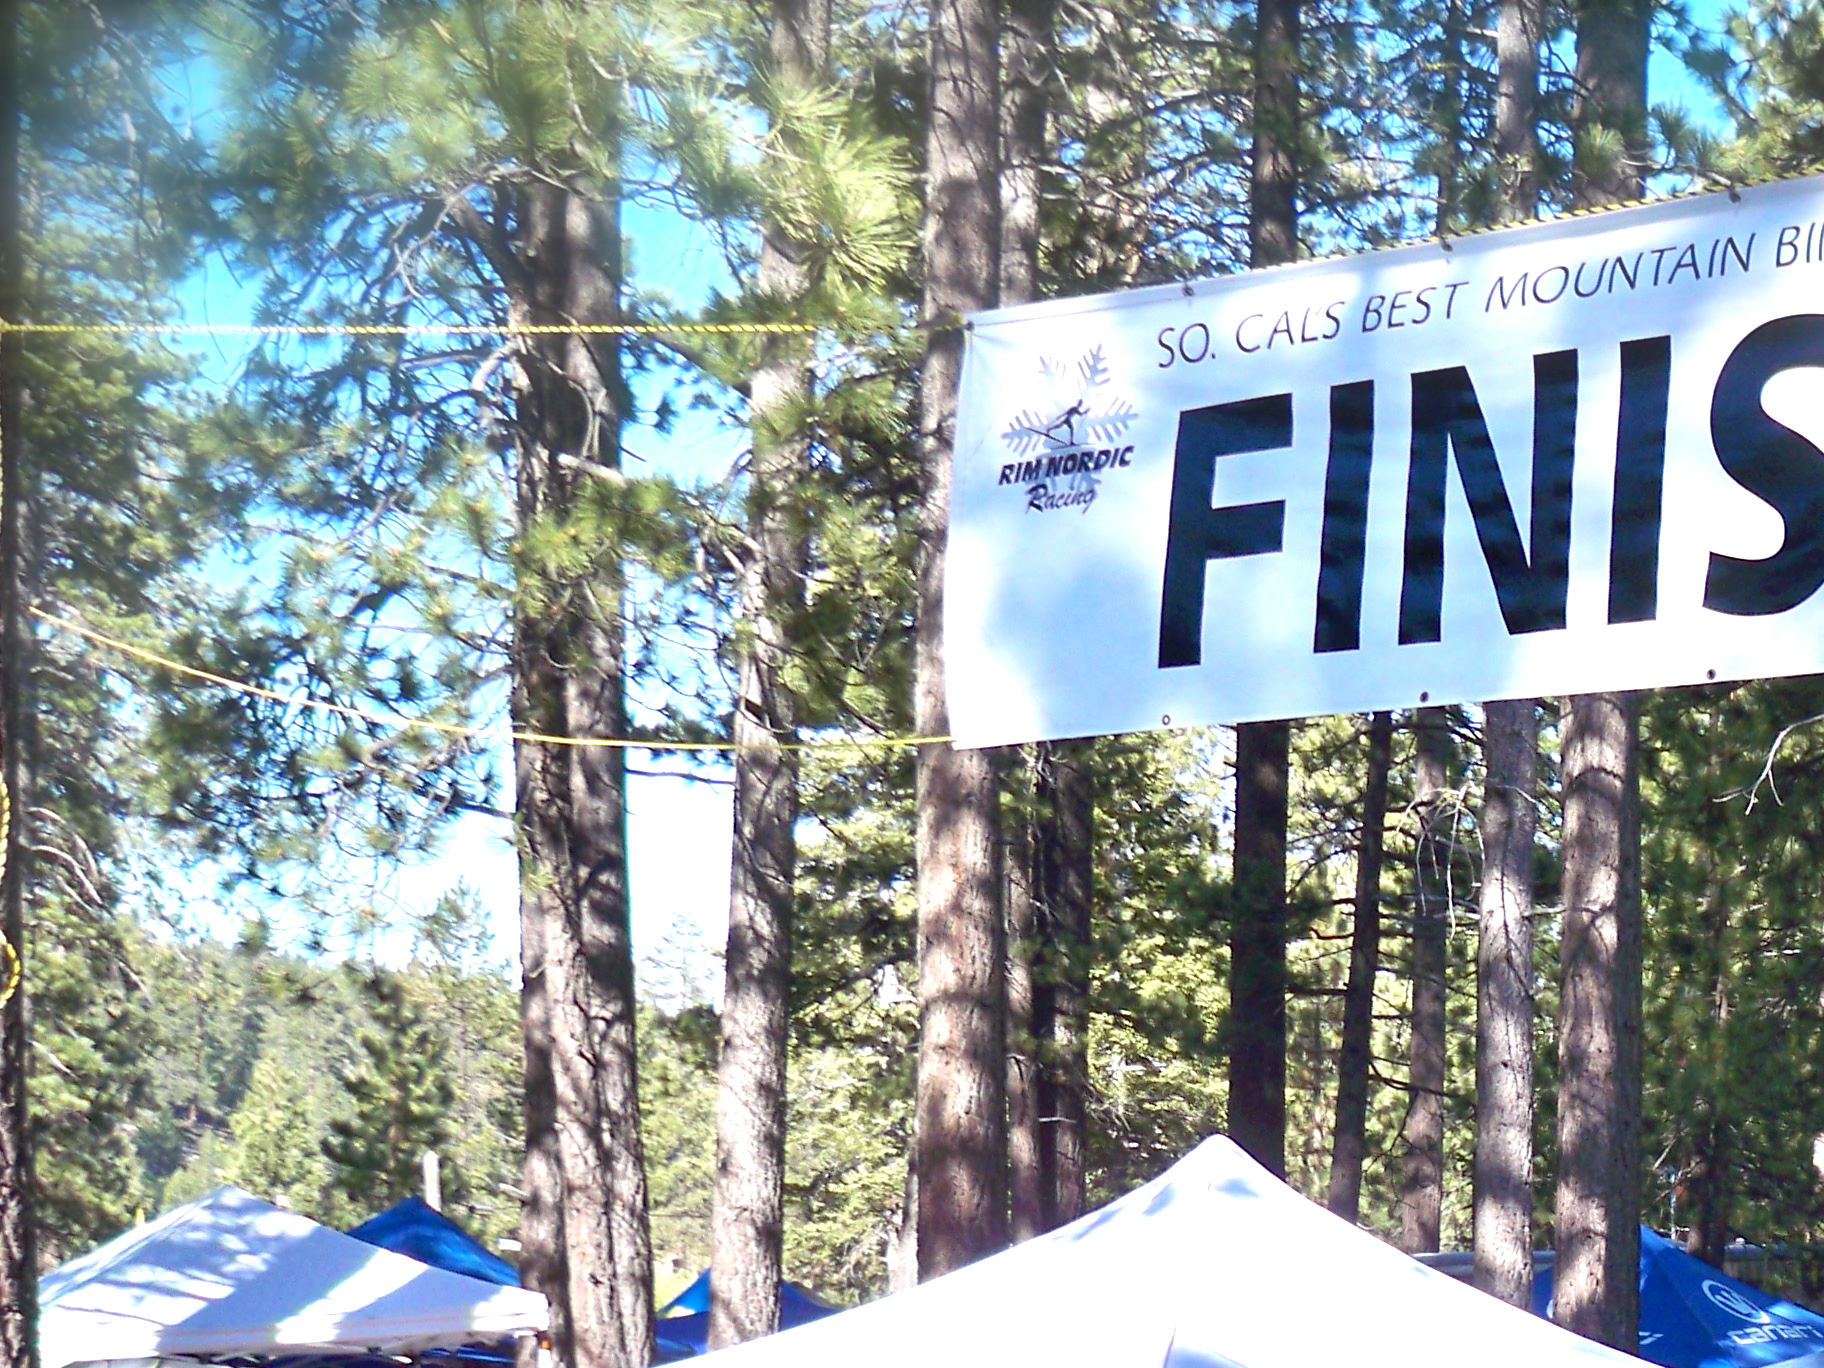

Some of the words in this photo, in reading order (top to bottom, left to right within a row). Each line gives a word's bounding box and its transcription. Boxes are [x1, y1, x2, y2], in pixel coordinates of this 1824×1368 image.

[1158, 322, 1217, 368] SO.
[1362, 281, 1469, 333] BEST
[1485, 232, 1756, 314] MOUNTAIN
[999, 459, 1042, 485] RIM
[1045, 445, 1135, 478] NORDIC
[1025, 483, 1096, 514] Racing
[1727, 1325, 1824, 1345] canari
